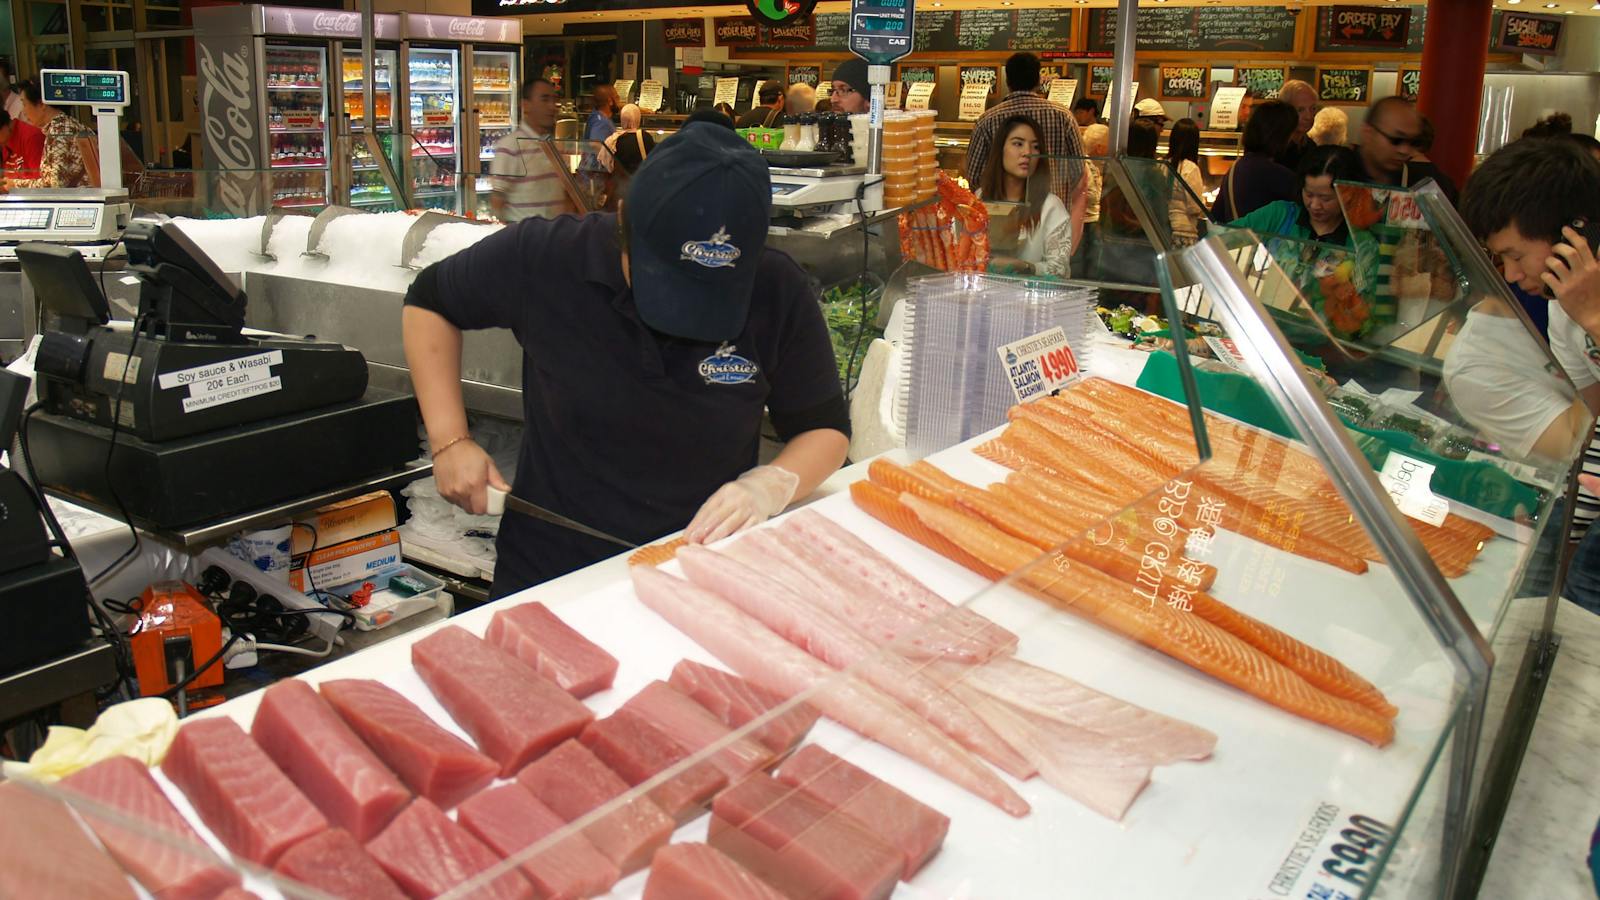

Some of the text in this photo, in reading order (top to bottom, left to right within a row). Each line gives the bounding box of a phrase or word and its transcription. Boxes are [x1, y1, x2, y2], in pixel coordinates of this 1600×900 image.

[313, 12, 358, 32] Coca-Cola
[448, 18, 486, 36] Coca-Cola
[1338, 12, 1402, 29] ORDER PAY
[1508, 17, 1539, 34] SUSHI
[717, 26, 740, 37] ORDER
[961, 70, 996, 80] SNAPPER
[1182, 68, 1205, 79] BABY
[1246, 69, 1283, 81] LOBSTER
[1168, 79, 1202, 91] OCTOPUS
[177, 354, 272, 384] Soy sauce & Wasabi
[1009, 359, 1037, 378] ATLANTIC
[206, 374, 250, 391] 20¢ Each
[1013, 371, 1041, 390] SALMON
[185, 395, 216, 409] MINIMUM
[366, 555, 397, 570] MEDIUM
